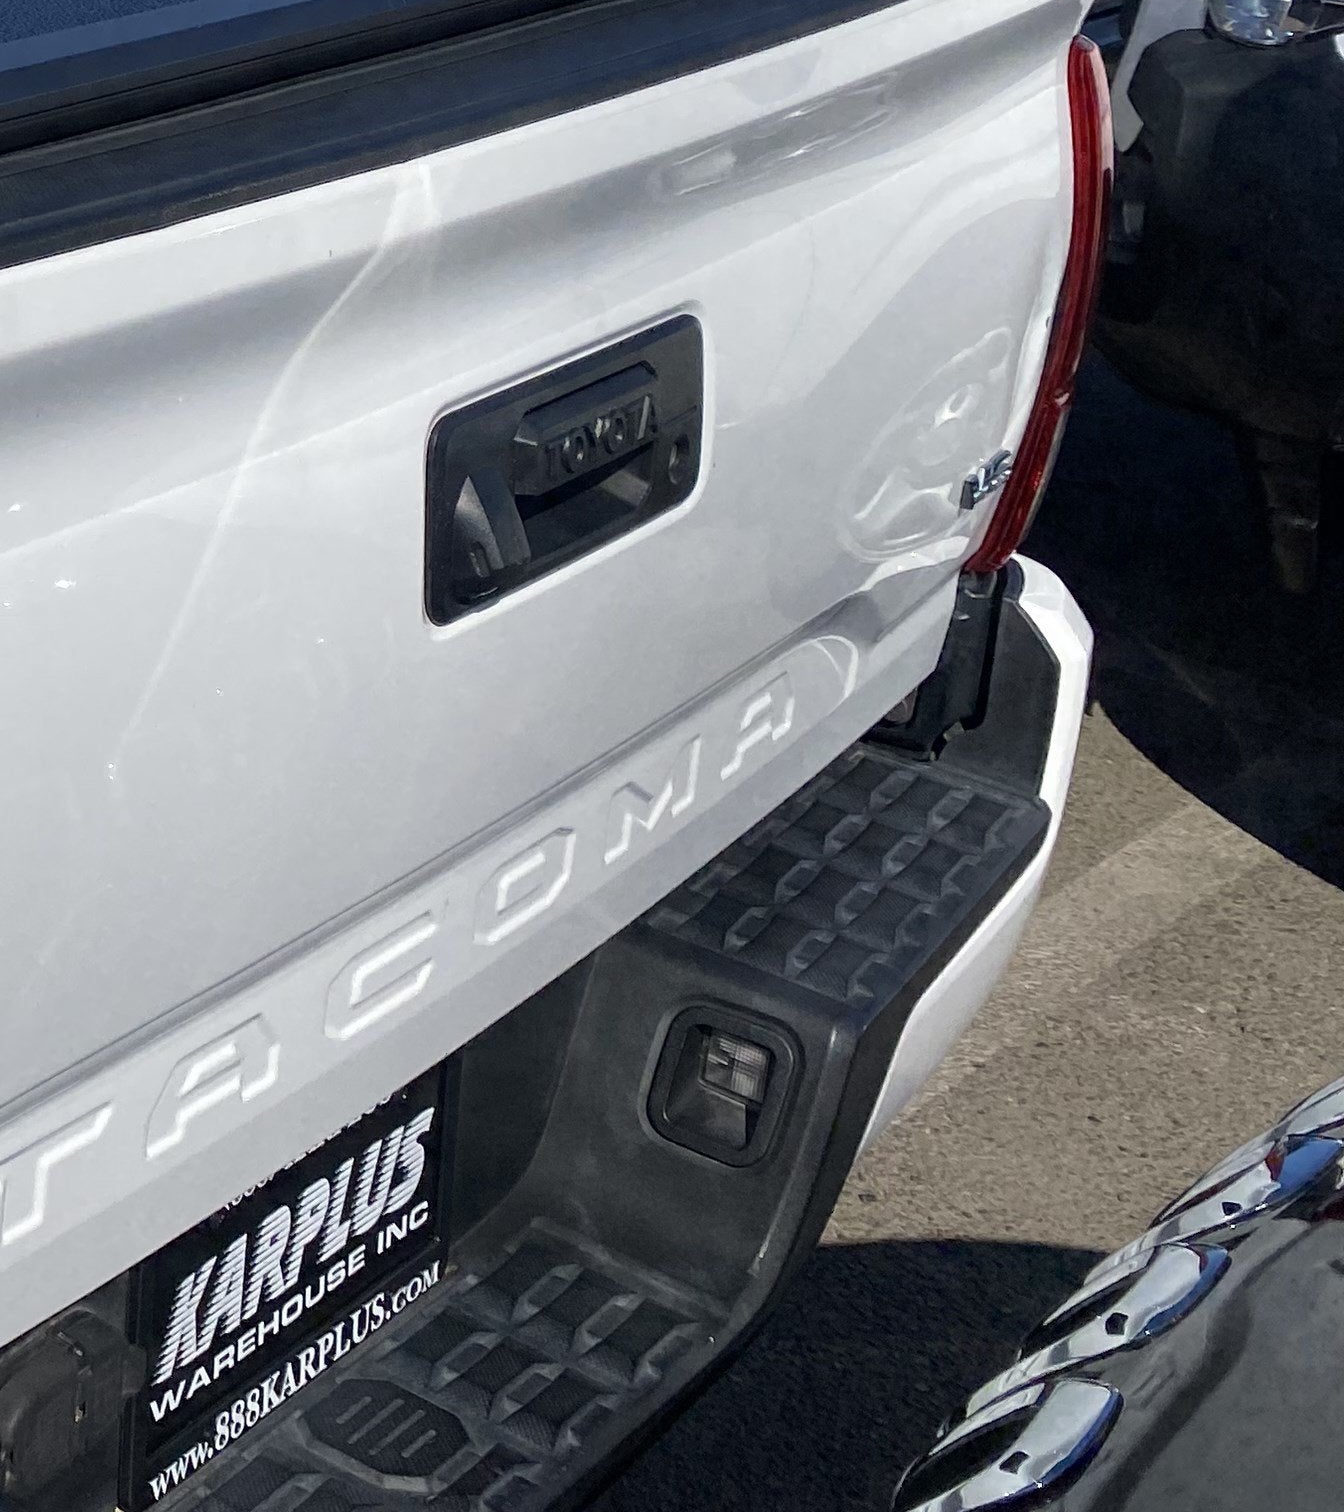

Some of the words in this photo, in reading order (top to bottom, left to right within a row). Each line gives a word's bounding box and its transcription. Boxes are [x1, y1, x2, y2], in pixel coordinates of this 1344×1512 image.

[540, 393, 659, 482] TOYOTA
[149, 1244, 367, 1422] WAREHOUSE
[376, 1200, 430, 1254] INC
[151, 1106, 435, 1388] KARPLUS
